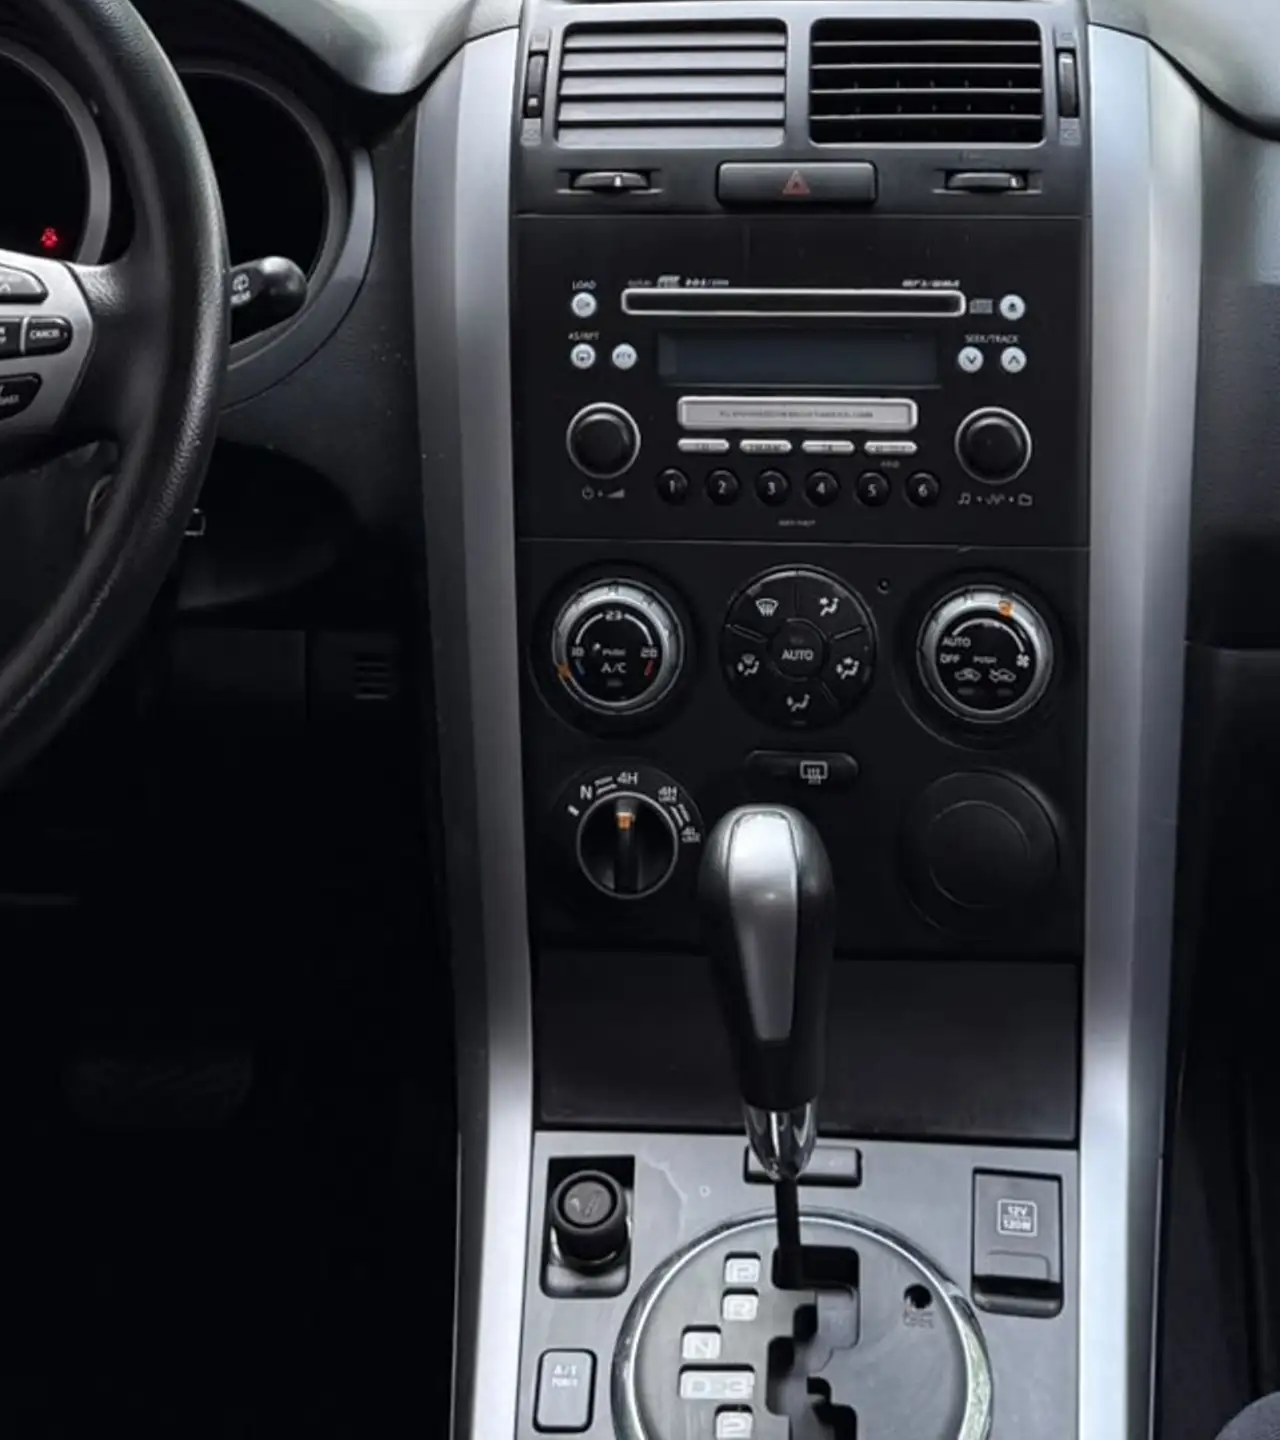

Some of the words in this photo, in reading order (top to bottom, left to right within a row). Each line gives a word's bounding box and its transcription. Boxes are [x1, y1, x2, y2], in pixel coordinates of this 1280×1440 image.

[718, 480, 727, 494] 2
[767, 482, 776, 495] 3
[816, 481, 826, 495] 4
[868, 483, 877, 497] 5
[918, 484, 927, 498] 6
[605, 610, 623, 621] 23
[942, 636, 971, 648] AUTO
[781, 648, 814, 661] AUTO
[601, 662, 627, 674] A/C
[616, 771, 638, 785] 4H
[580, 784, 593, 800] N
